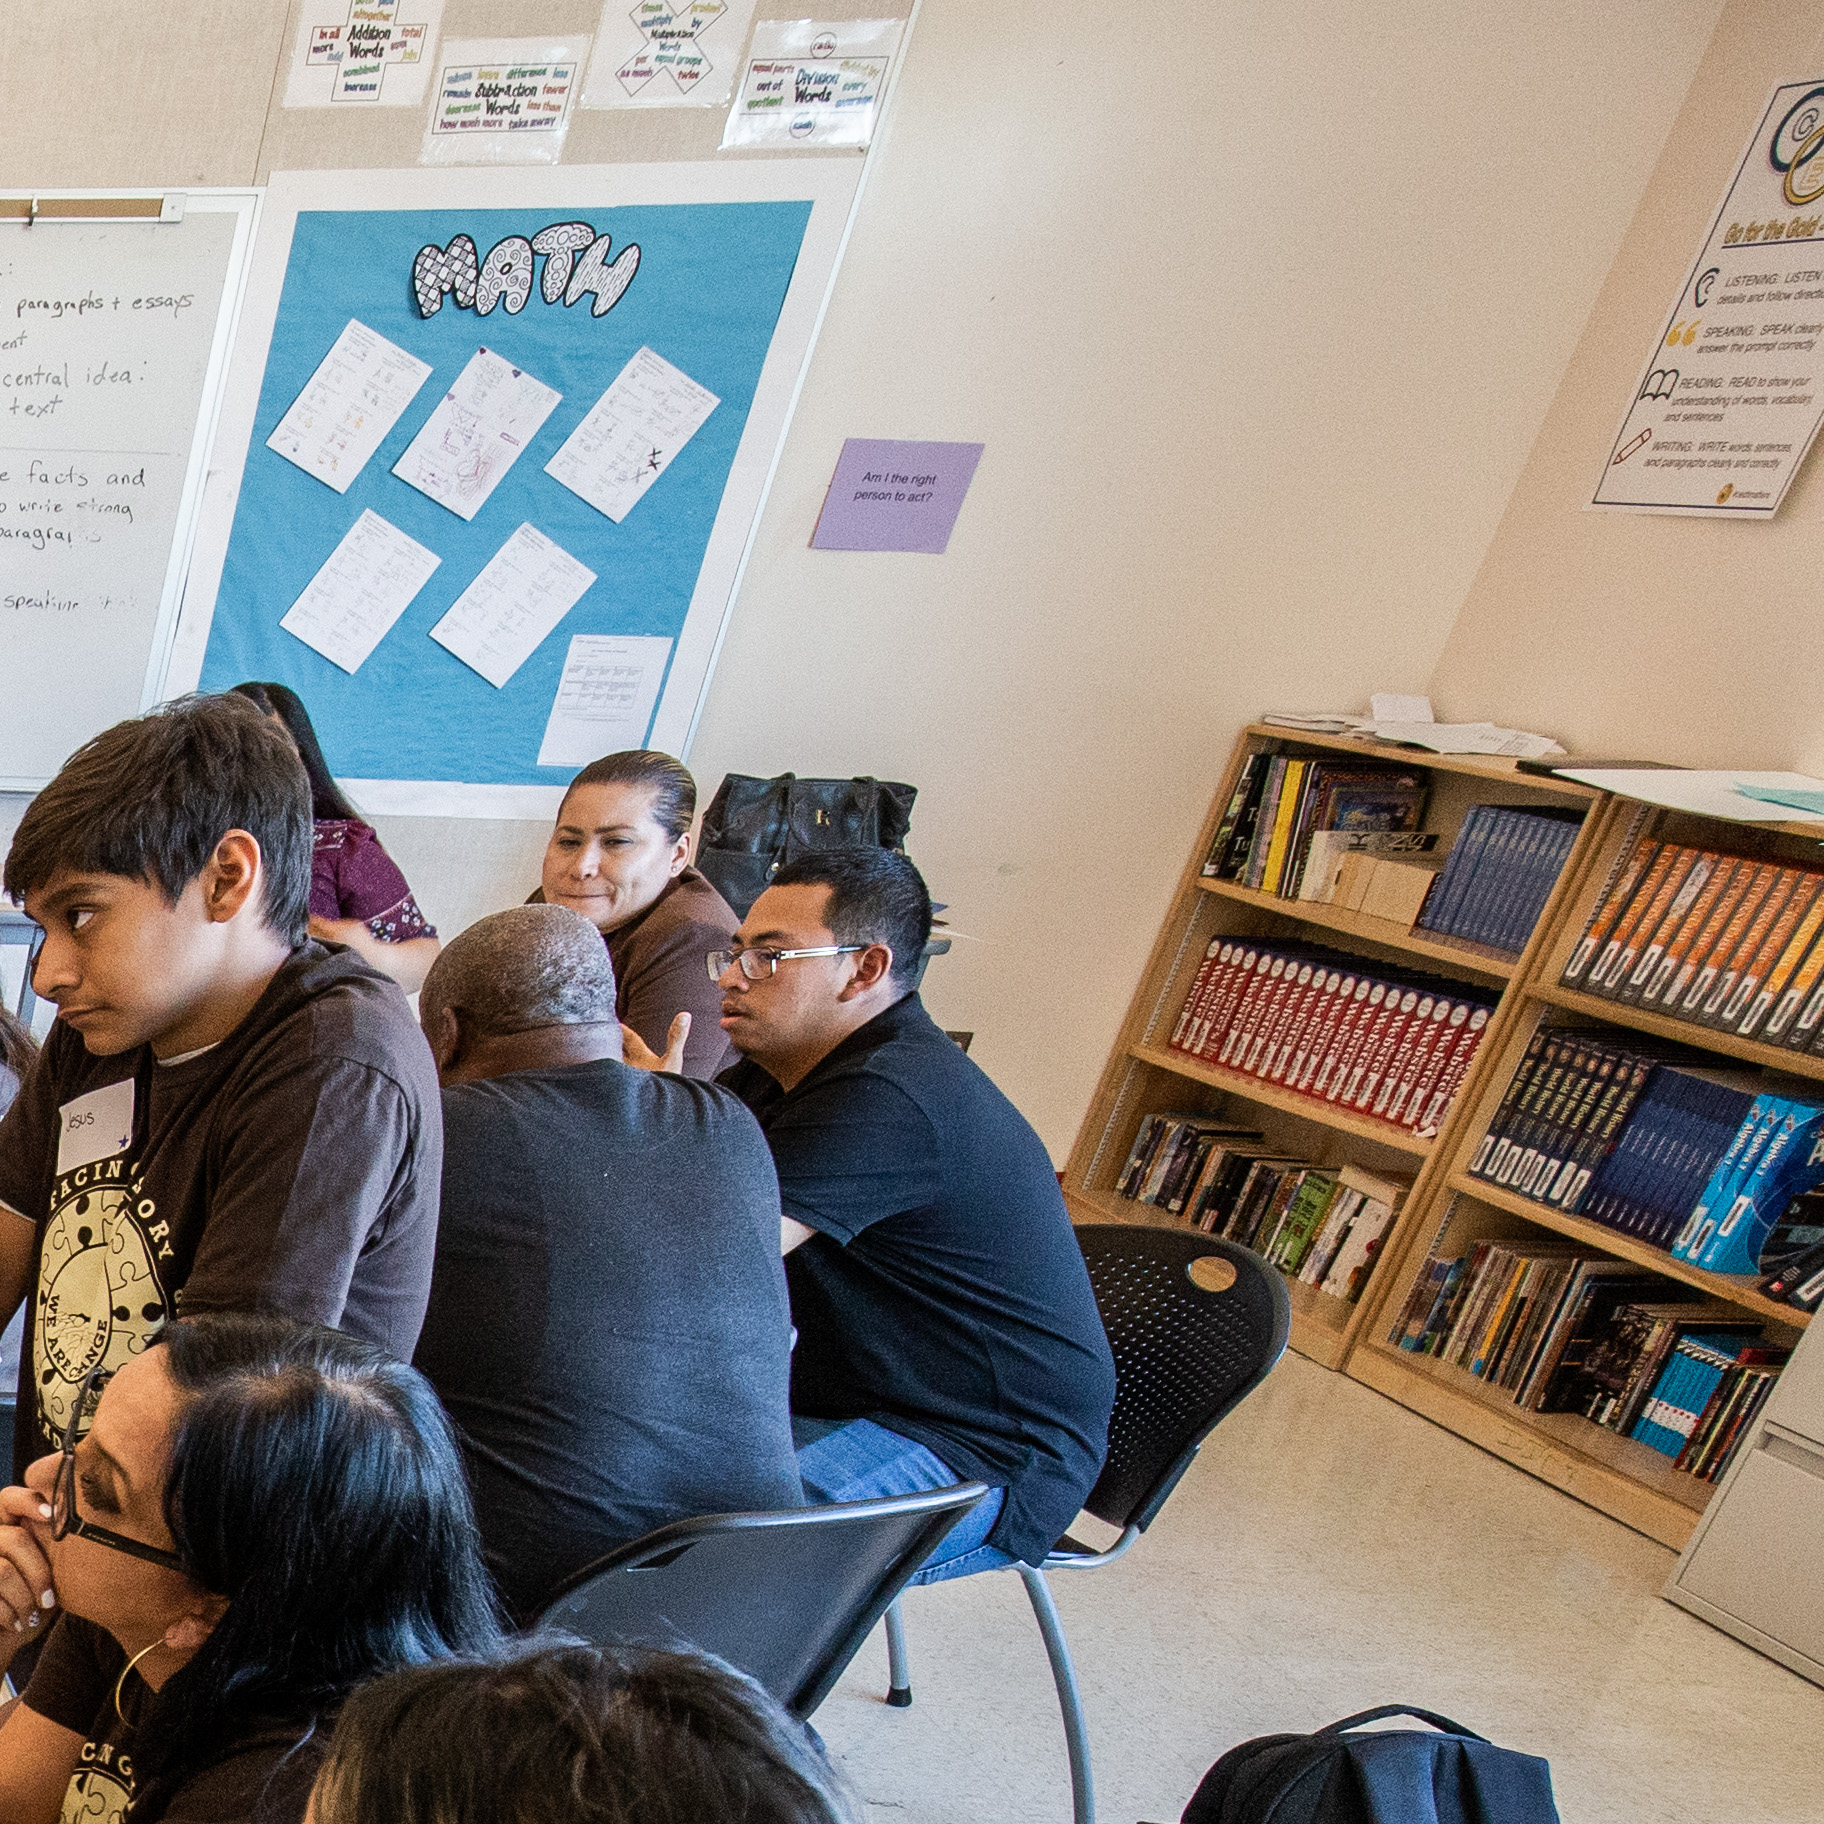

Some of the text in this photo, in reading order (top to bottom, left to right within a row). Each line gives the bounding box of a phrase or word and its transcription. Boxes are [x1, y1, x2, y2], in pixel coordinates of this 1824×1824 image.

[347, 24, 391, 41] Addition
[349, 42, 384, 58] Words
[795, 69, 839, 86] Division
[475, 83, 536, 98] Subtraction
[795, 87, 832, 104] Words
[485, 100, 520, 115] Words
[414, 221, 641, 319] MATH
[16, 291, 104, 320] paragraphs
[131, 292, 195, 320] essays
[3, 361, 70, 388] central
[9, 395, 63, 416] text
[27, 459, 89, 487] facts
[105, 467, 146, 488] and
[862, 472, 882, 482] Am
[890, 473, 908, 484] the
[910, 474, 937, 487] right
[853, 490, 933, 502] person act?
[66, 1112, 95, 1132] Jesus
[1760, 1132, 1789, 1169] Algebra
